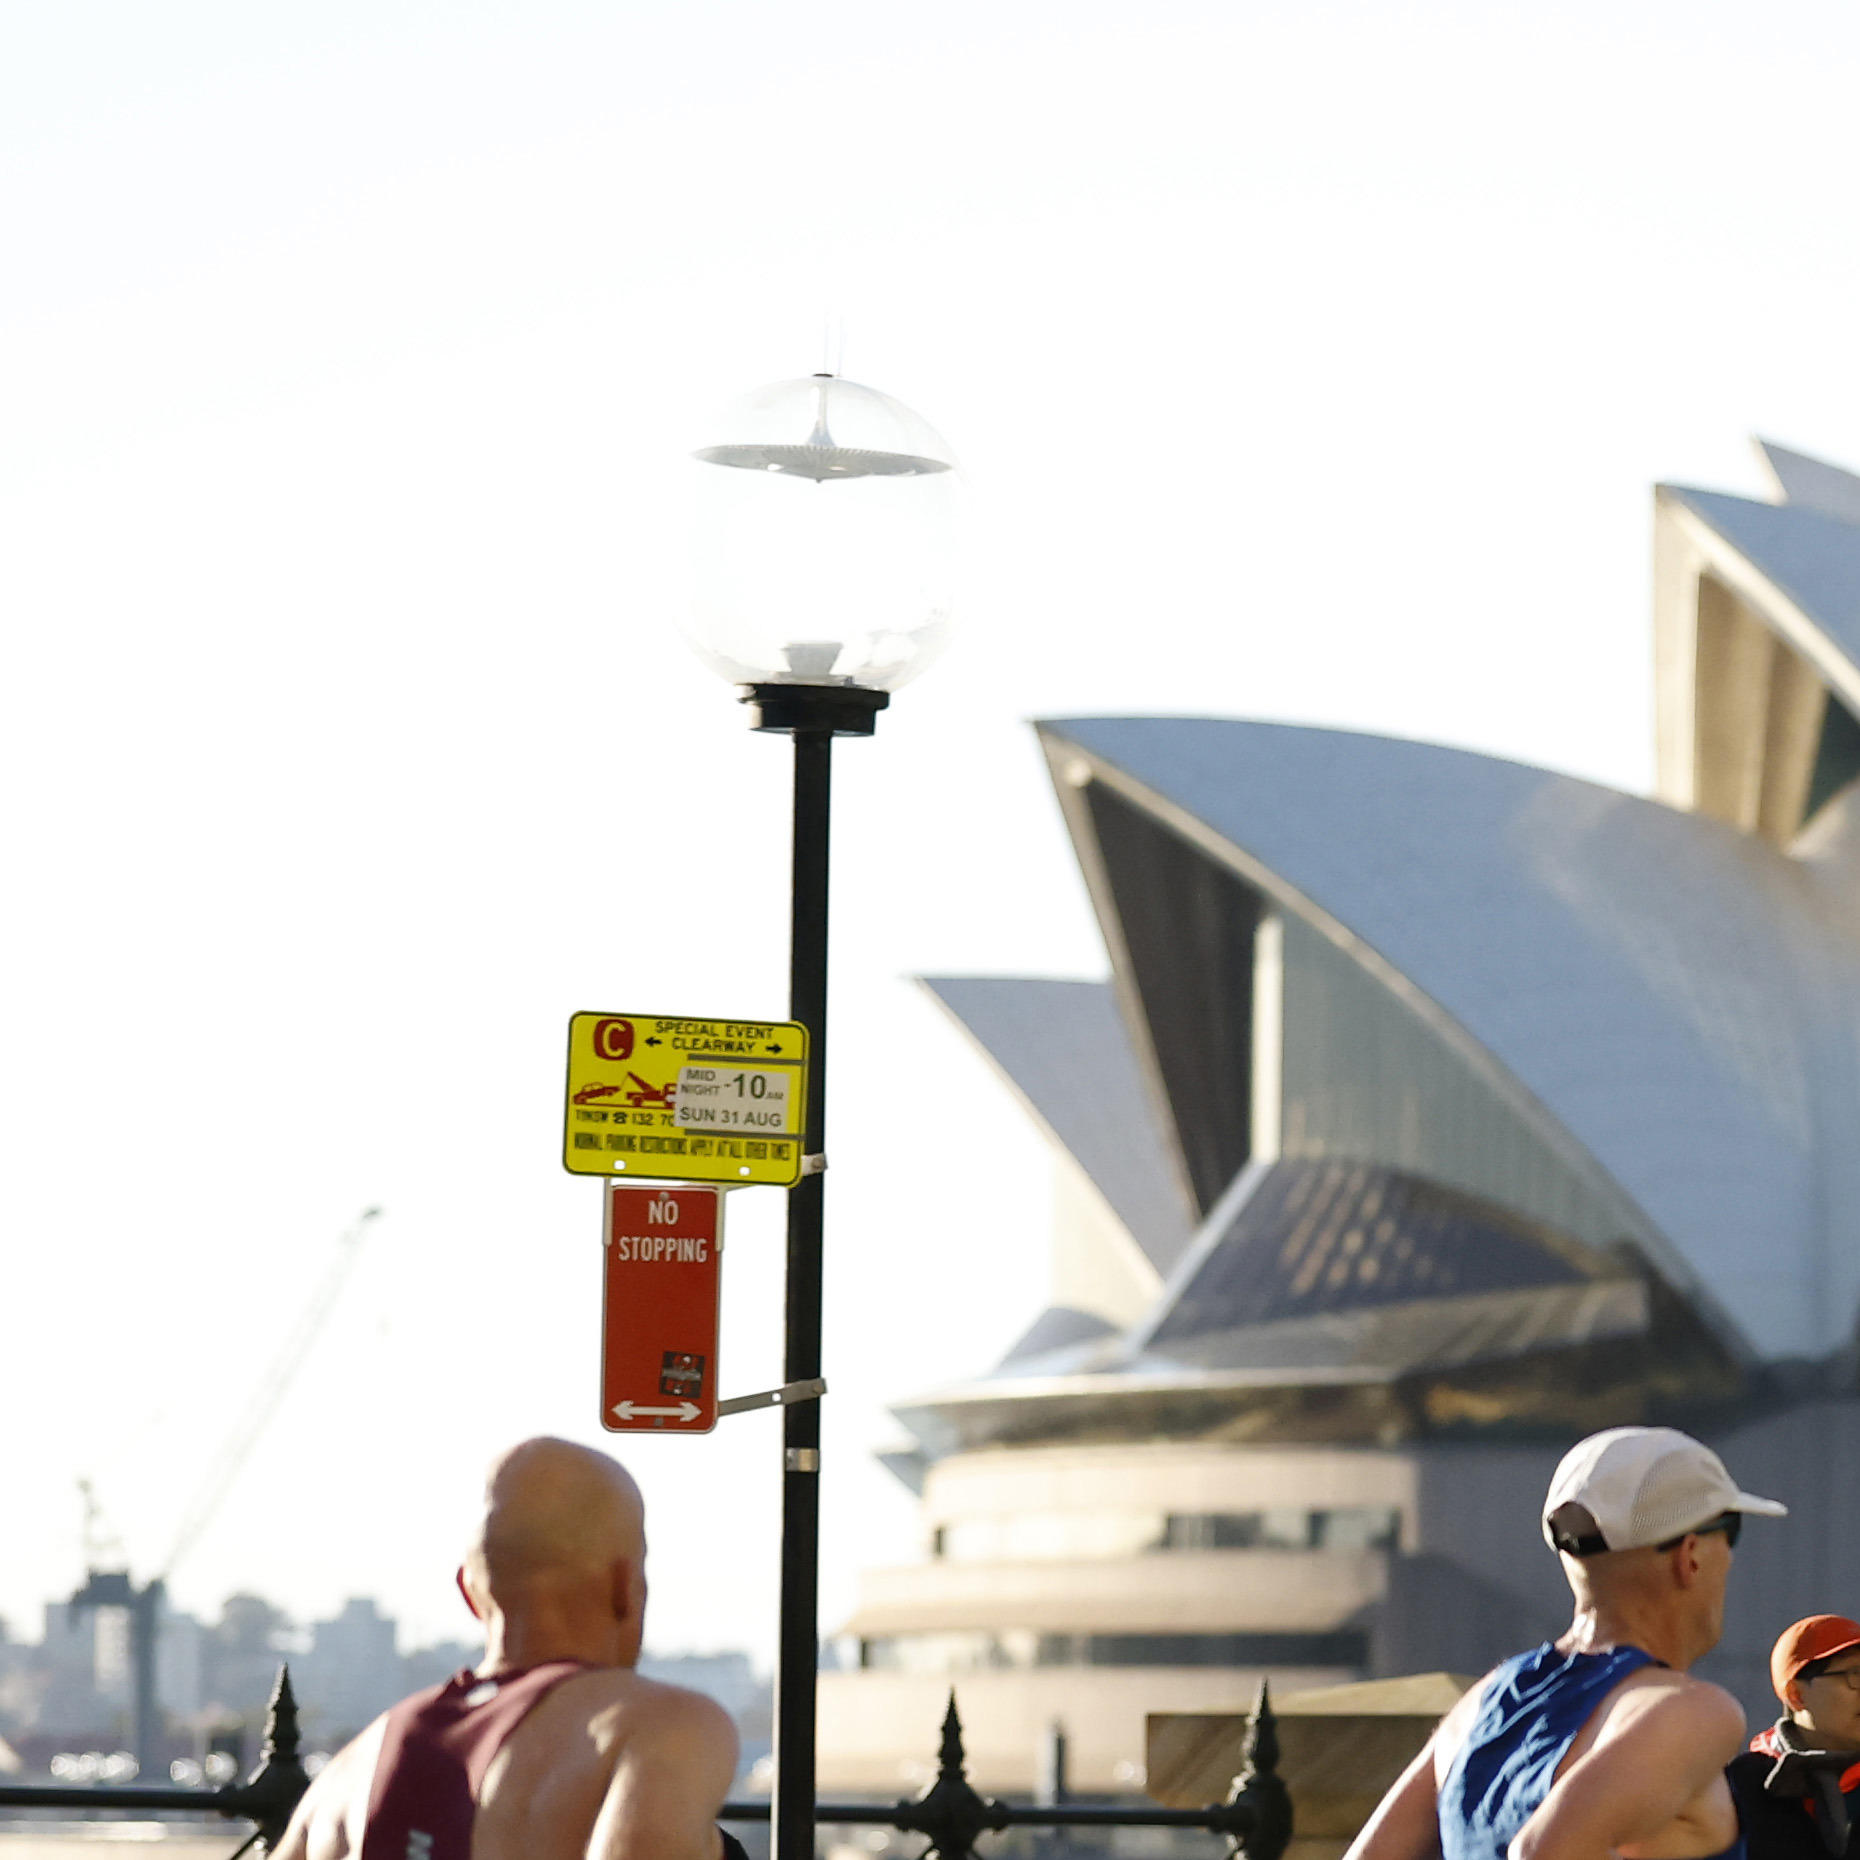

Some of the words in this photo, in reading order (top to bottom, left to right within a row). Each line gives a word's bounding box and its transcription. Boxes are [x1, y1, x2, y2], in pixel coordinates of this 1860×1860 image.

[602, 1021, 626, 1058] C
[654, 1021, 719, 1037] SPECIAL
[726, 1024, 774, 1040] EVENT
[671, 1037, 758, 1054] CLEARWAY
[686, 1068, 716, 1082] MID
[680, 1082, 720, 1096] NIGHT
[680, 1106, 716, 1122] SUN
[721, 1110, 739, 1125] 31
[743, 1111, 783, 1127] AUG
[647, 1199, 679, 1225] NO
[618, 1235, 708, 1263] STOPPING
